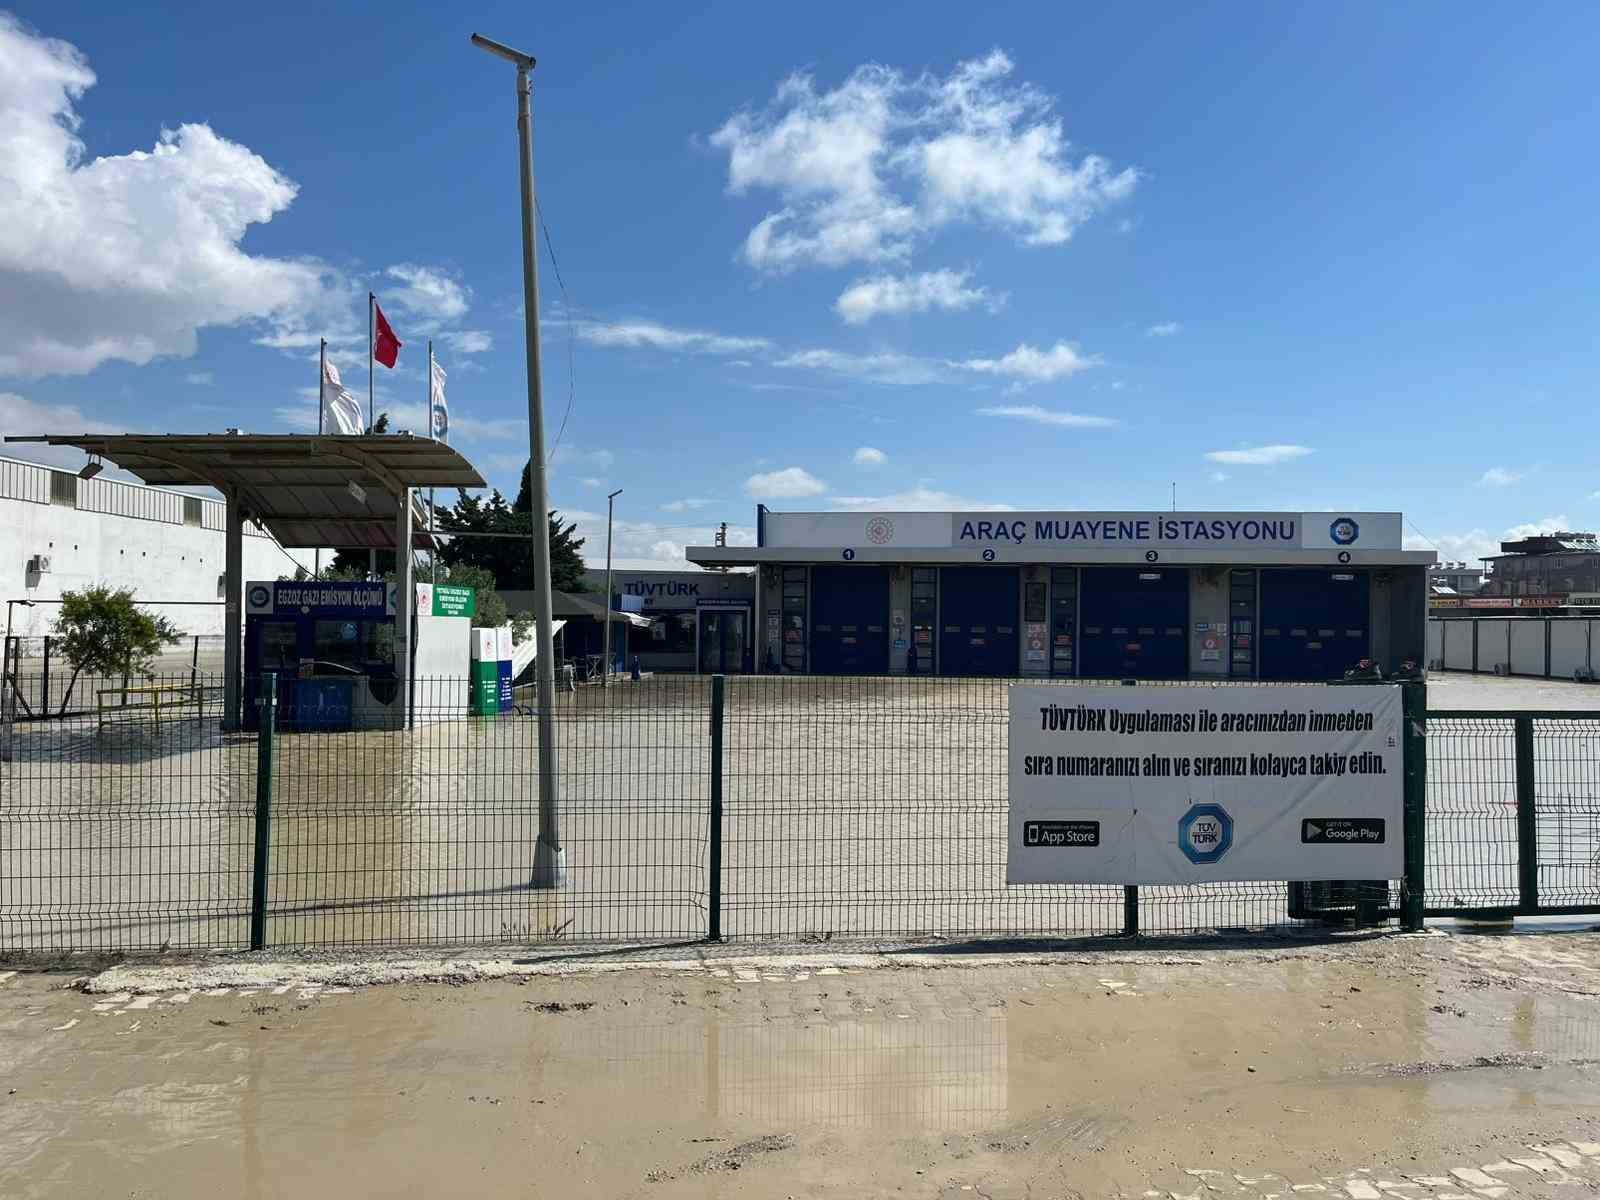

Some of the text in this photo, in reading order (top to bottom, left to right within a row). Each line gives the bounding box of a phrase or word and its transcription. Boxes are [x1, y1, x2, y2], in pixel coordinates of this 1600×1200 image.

[959, 515, 1295, 544] ARAÇ MUAYENE İSTASYONU
[278, 589, 302, 606] EGZOZ
[321, 586, 352, 606] EMİSYON
[354, 587, 383, 609] ÖLÇÜMÜ
[624, 581, 699, 596] TÜVTÜRK
[1040, 703, 1373, 735] TÜVTÜRK Uygulaması ile aracınızdan inmeden
[1024, 755, 1053, 776] sıra
[1057, 756, 1140, 777] numaranızı
[1142, 754, 1171, 777] alın
[1173, 757, 1191, 777] ve
[1193, 756, 1247, 777] sıranızı
[1250, 753, 1307, 778] kolayca
[1349, 751, 1387, 775] edin.
[1041, 831, 1095, 845] App Store
[1326, 828, 1379, 840] Google Play
